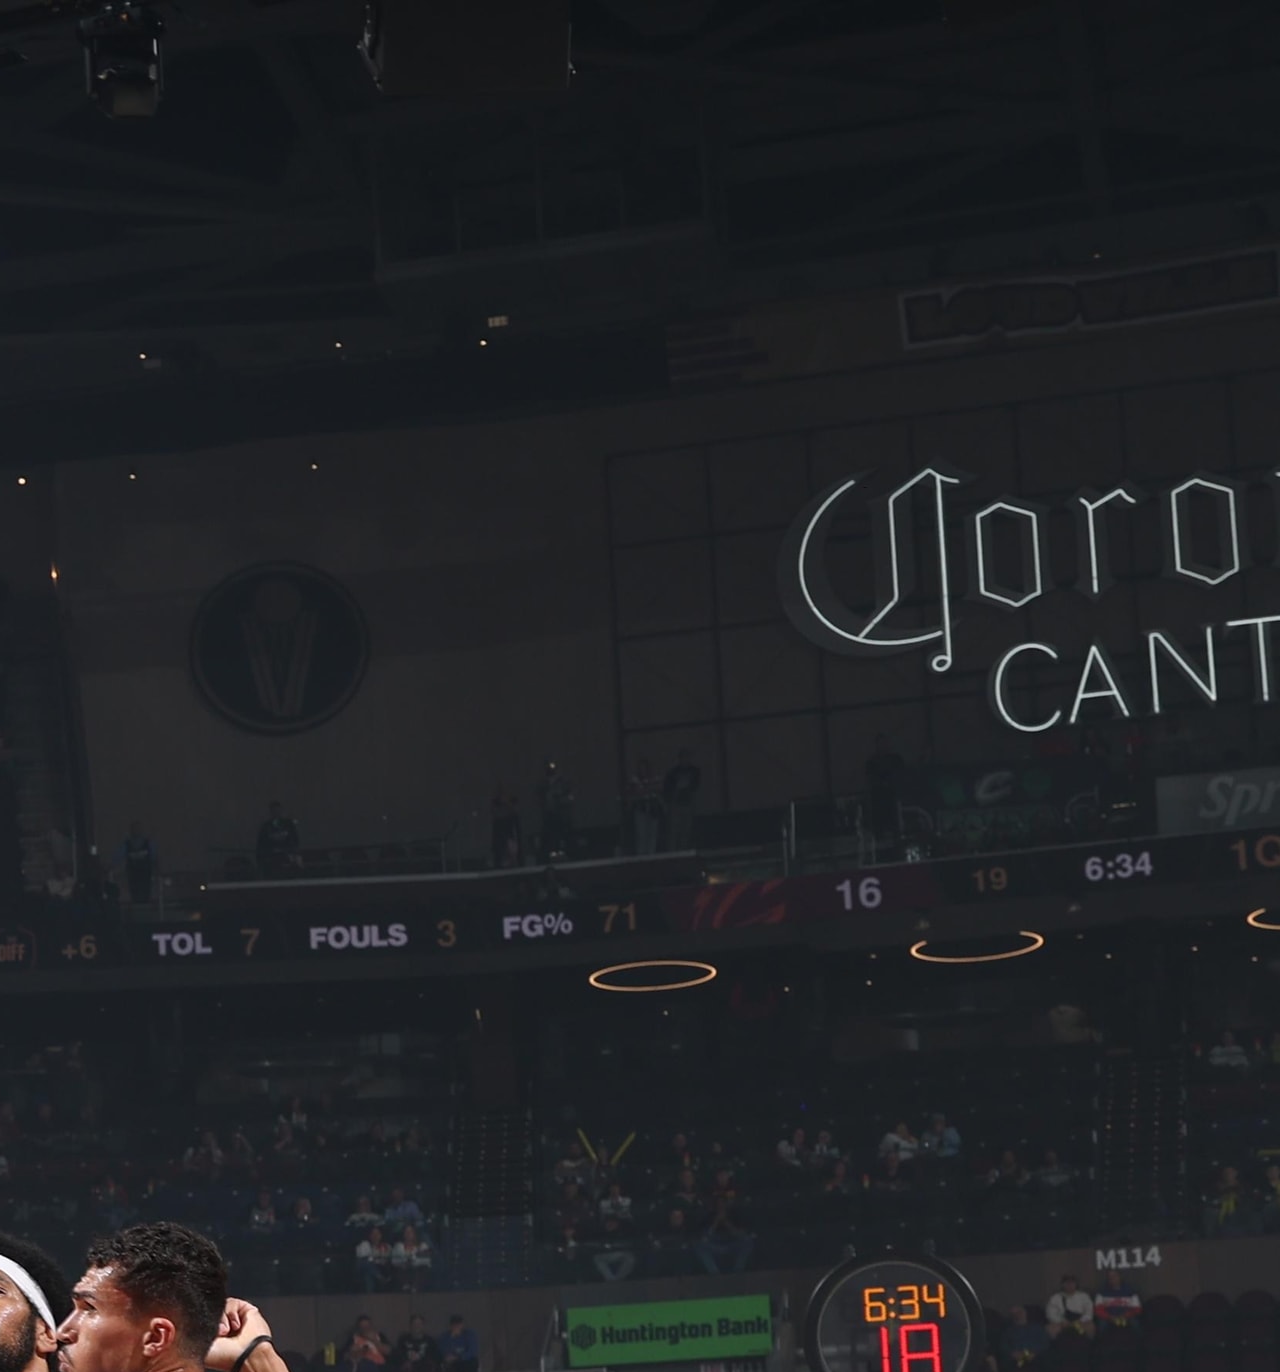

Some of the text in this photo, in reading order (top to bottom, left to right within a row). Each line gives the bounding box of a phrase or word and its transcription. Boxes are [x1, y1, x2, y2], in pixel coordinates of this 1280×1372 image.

[778, 466, 1280, 672] Coro
[972, 867, 1009, 894] 19
[1084, 851, 1154, 882] 6:34
[835, 876, 883, 910] 16
[308, 918, 458, 951] FOULS 3
[502, 903, 638, 941] FG% 71
[151, 927, 261, 957] TOL 7
[1096, 1246, 1162, 1270] M114
[863, 1284, 946, 1322] 6:34
[601, 1316, 769, 1345] Huntington Bank
